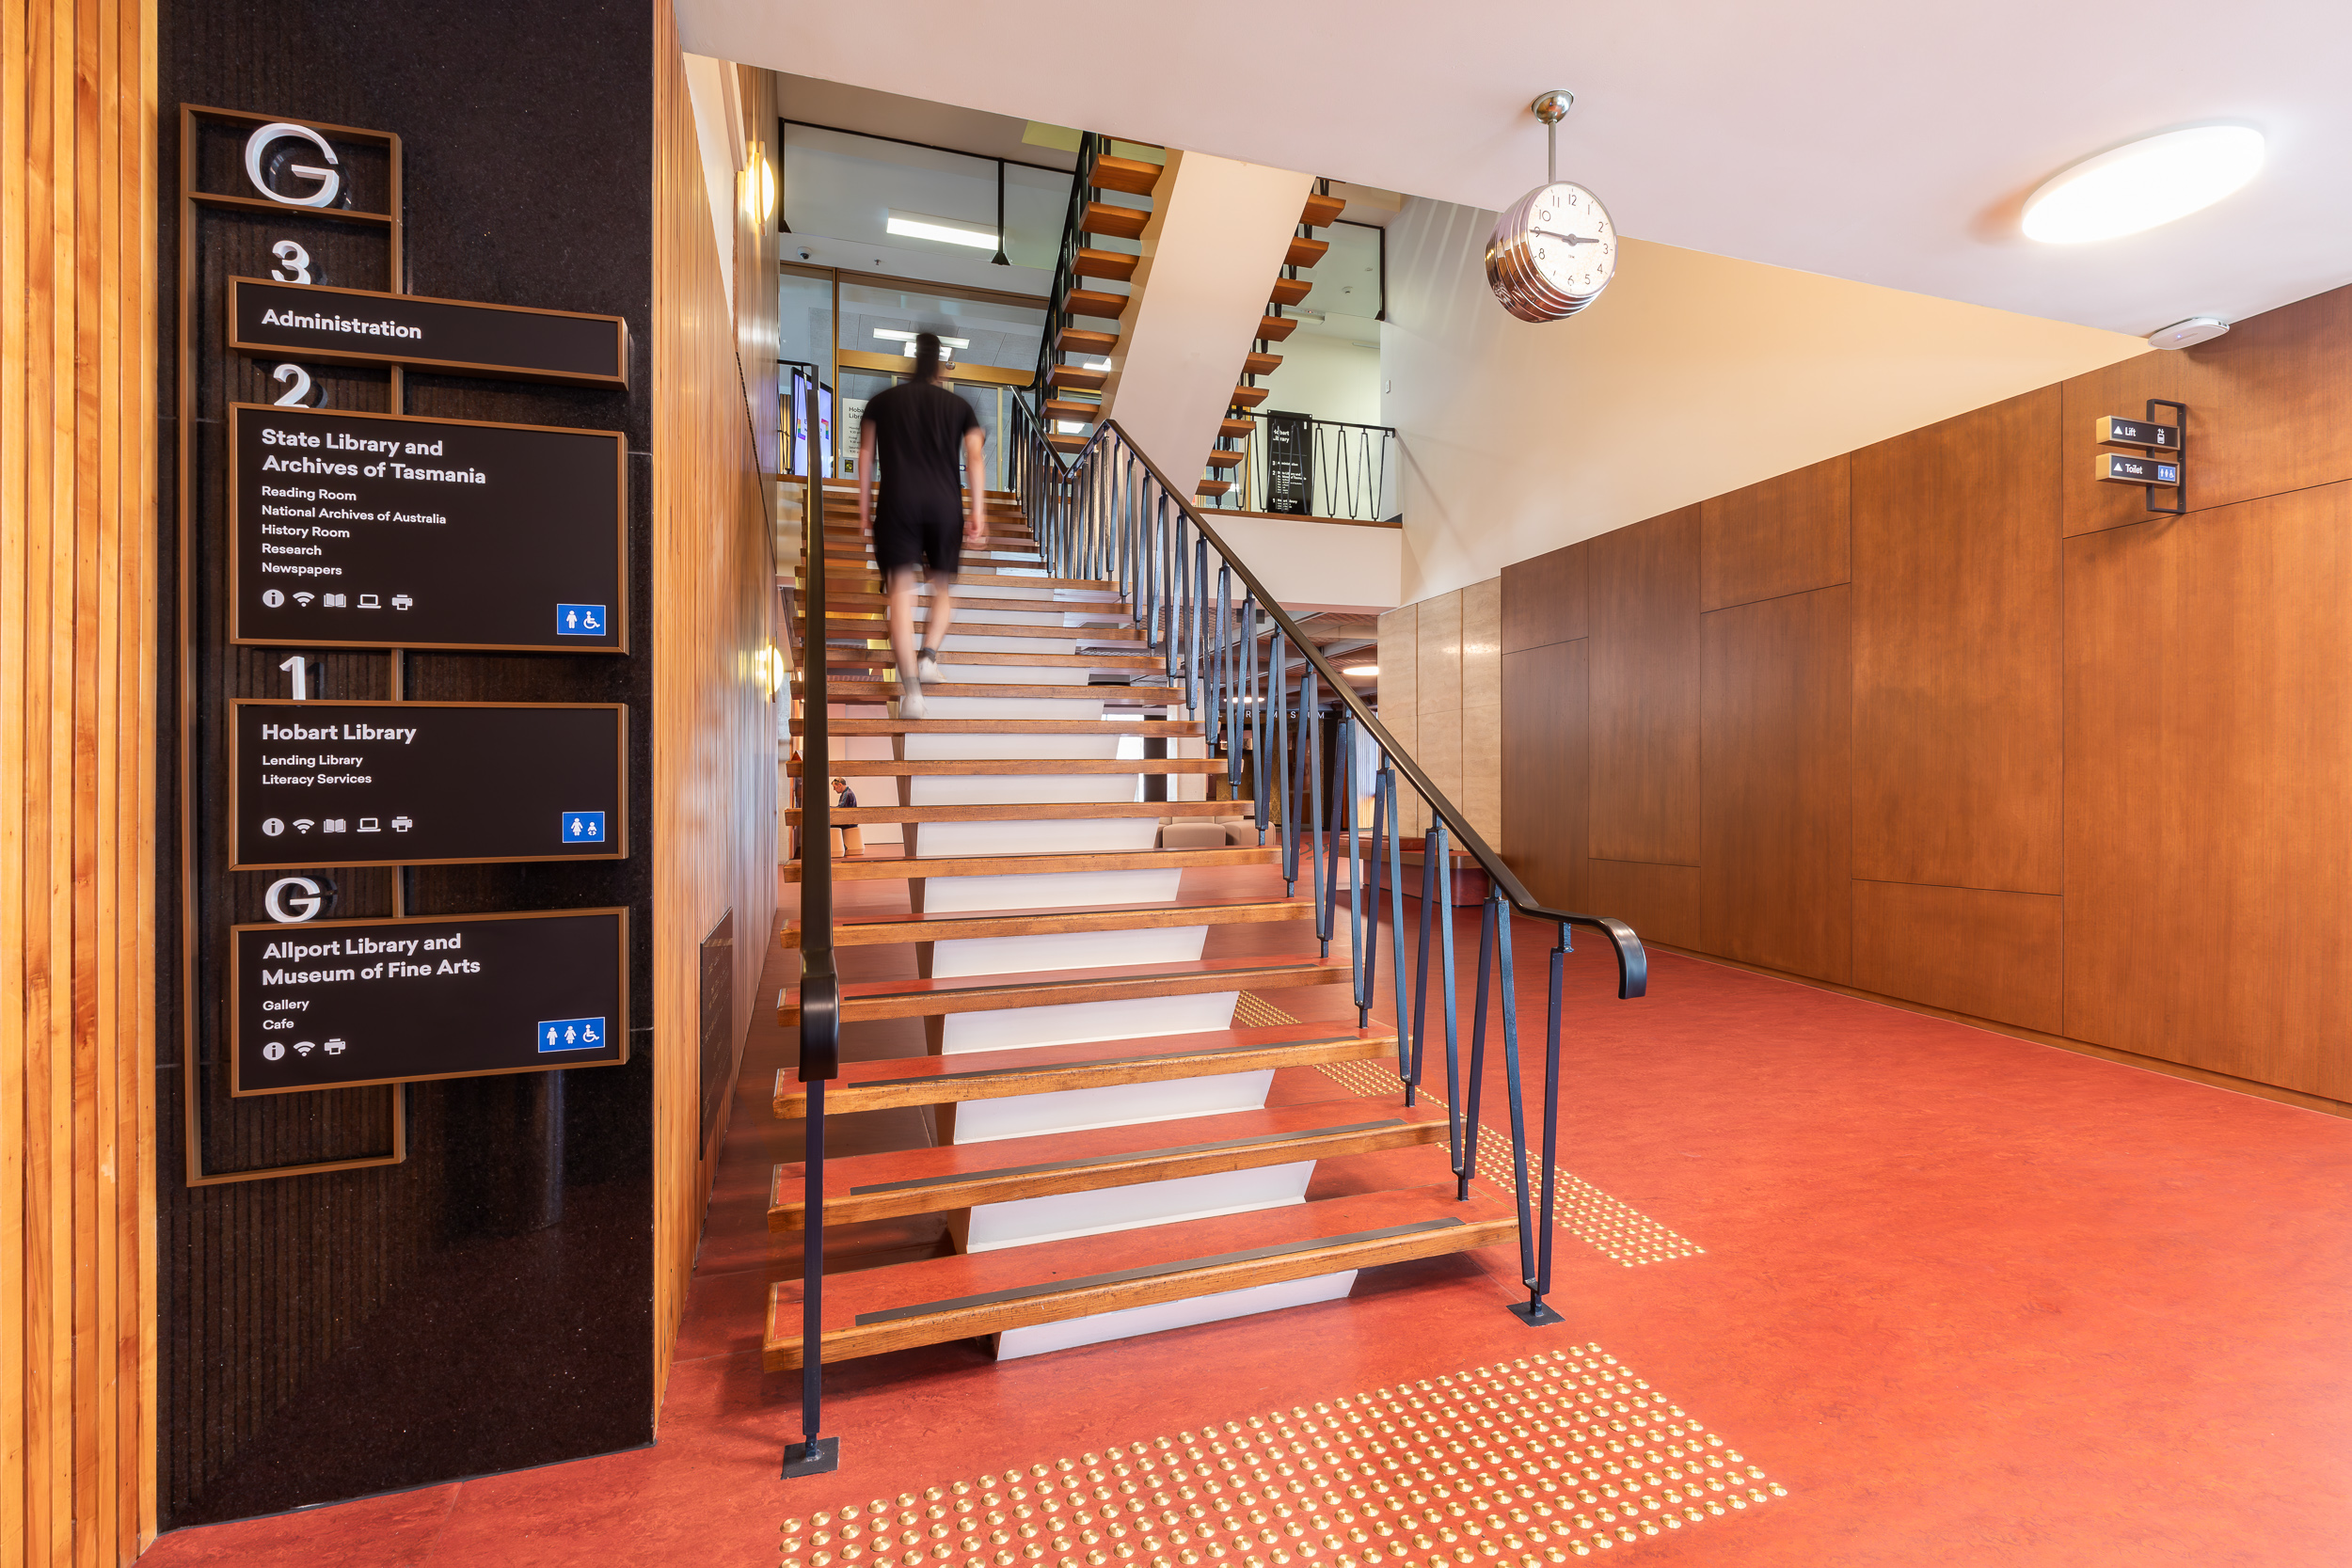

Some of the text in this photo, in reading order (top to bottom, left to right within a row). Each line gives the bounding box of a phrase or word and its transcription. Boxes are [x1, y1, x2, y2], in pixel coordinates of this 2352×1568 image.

[245, 122, 340, 209] G
[1552, 195, 1560, 208] 11
[1568, 194, 1578, 207] 12
[1538, 209, 1551, 222] 10
[1597, 221, 1605, 233] 2
[1538, 248, 1546, 261] 8
[1602, 243, 1610, 255] 3
[271, 240, 311, 286] 3
[1597, 263, 1603, 275] 4
[1567, 275, 1575, 287] 6
[1584, 274, 1591, 285] 5
[261, 309, 421, 340] Administration
[273, 363, 311, 409] 2
[2124, 426, 2137, 437] Lift
[262, 428, 443, 458] State Library and
[262, 454, 486, 484] Archives of Tasmania
[2124, 464, 2143, 475] Toilet
[262, 485, 358, 502] Reading Room
[262, 504, 447, 525] National Archives of Australia
[262, 523, 350, 539] History Room
[262, 543, 323, 556] Research
[262, 562, 342, 578] Newspapers
[278, 656, 307, 701] 1
[262, 723, 417, 745] Hobart Library
[262, 754, 364, 768] Lending Library
[262, 773, 373, 787] Literacy Services
[264, 877, 321, 925] G
[262, 932, 461, 963] Allport Library and
[262, 958, 481, 986] Museum of Fine Arts
[262, 999, 310, 1012] Gallery
[262, 1018, 294, 1031] Cafe
